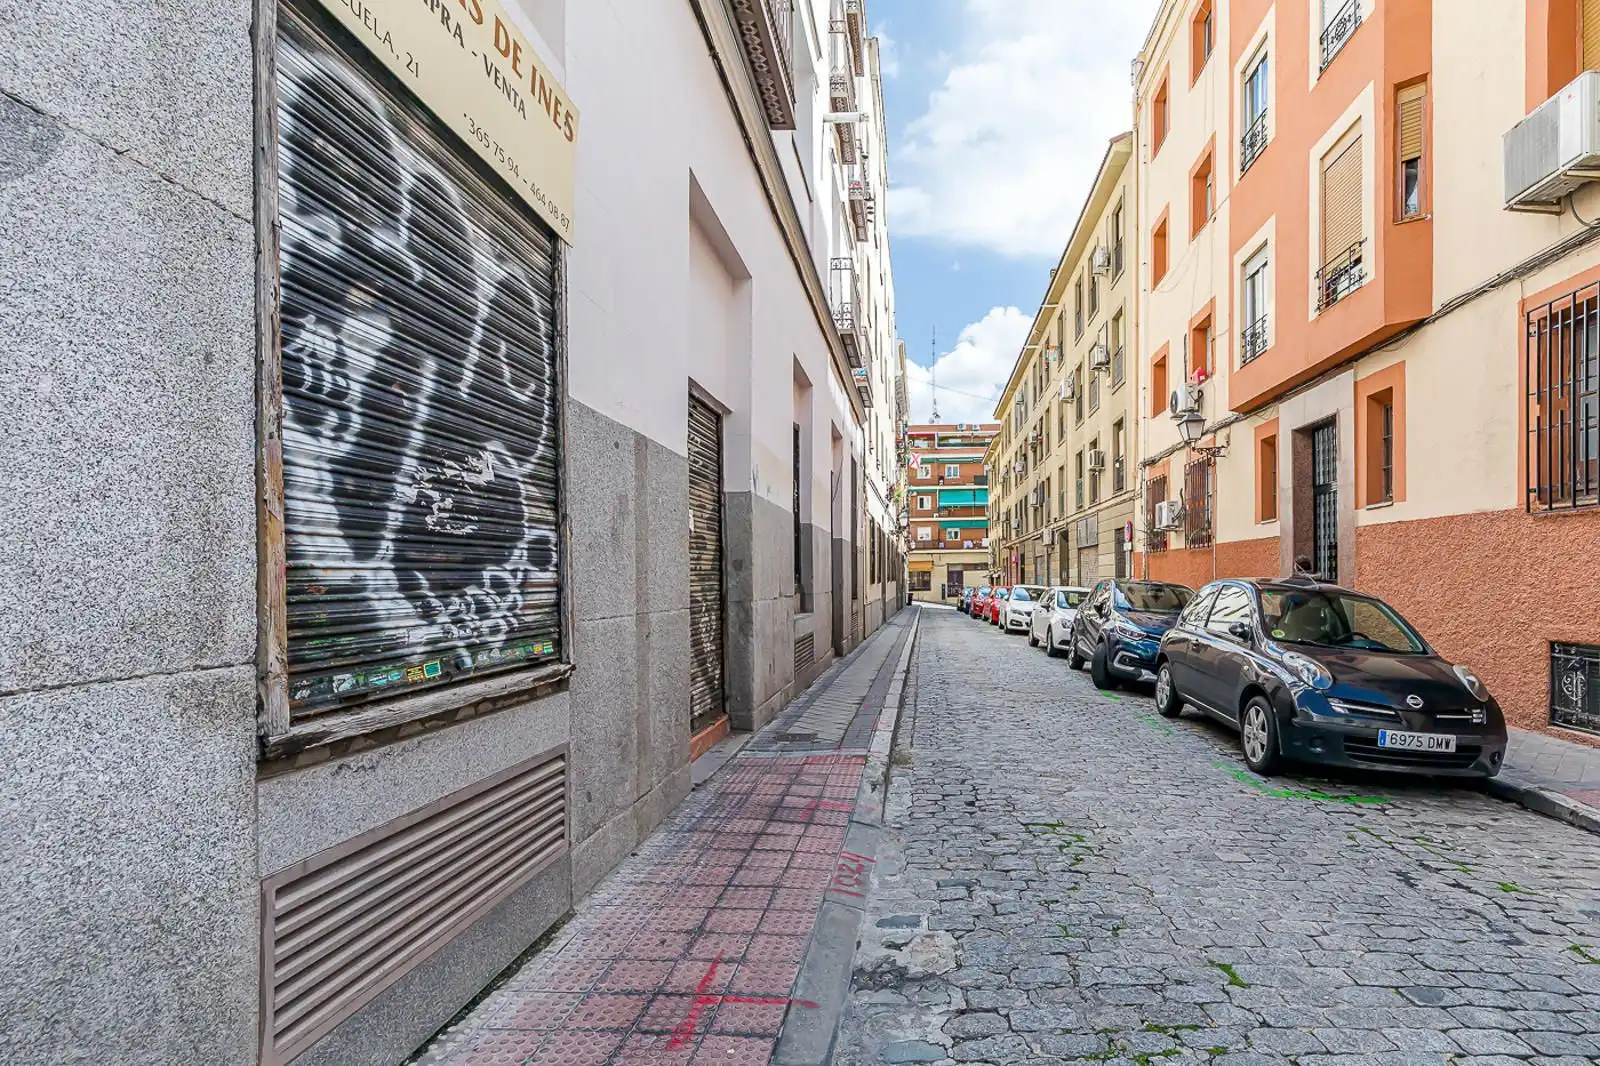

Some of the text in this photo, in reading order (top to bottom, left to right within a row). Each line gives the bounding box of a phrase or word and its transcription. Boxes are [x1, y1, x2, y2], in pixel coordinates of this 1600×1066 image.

[405, 51, 419, 79] 21
[483, 53, 527, 120] VENTA
[493, 13, 523, 80] DE
[530, 64, 574, 143] INES
[469, 117, 490, 149] 365
[493, 140, 505, 163] 75
[507, 156, 520, 178] 94
[529, 183, 546, 205] 464
[548, 200, 559, 220] 08
[560, 213, 570, 232] 87
[1390, 732, 1424, 748] 6975
